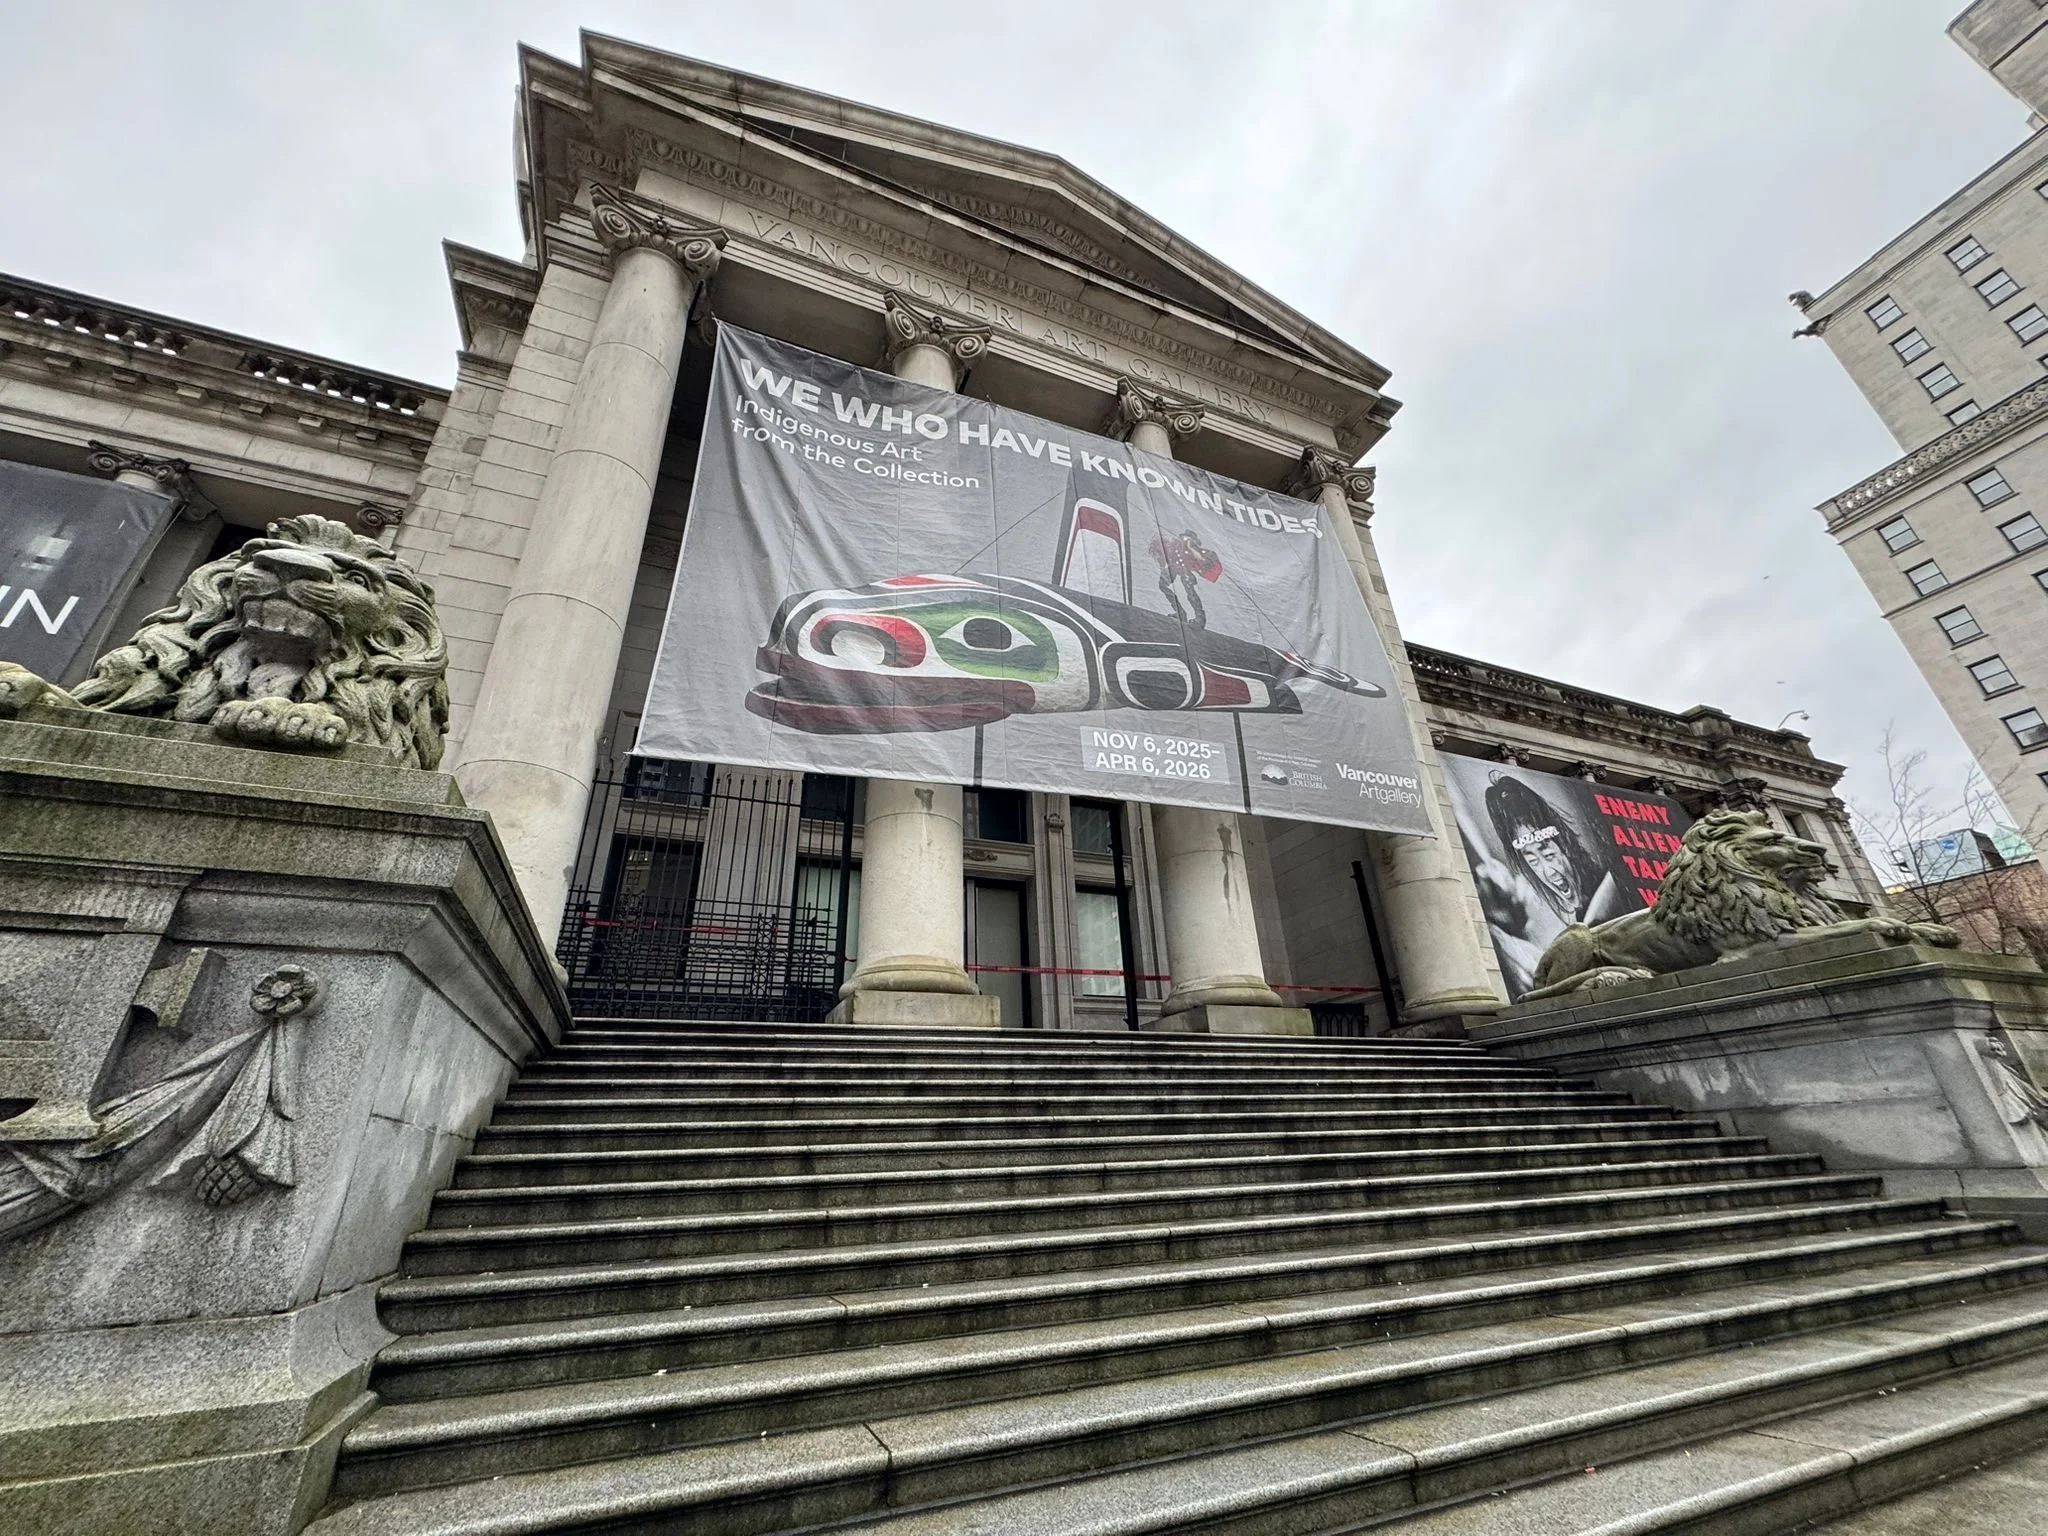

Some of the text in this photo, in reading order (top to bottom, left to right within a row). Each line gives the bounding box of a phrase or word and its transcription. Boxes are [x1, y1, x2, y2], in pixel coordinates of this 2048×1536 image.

[747, 211, 1273, 425] VANCOUVER ART GALLERY
[735, 394, 923, 463] Indigenous Art
[731, 418, 980, 489] from the Collection
[739, 358, 1323, 539] WE WHO HAVE KNOWN TIDES
[1093, 731, 1138, 751] NOV
[1143, 736, 1161, 755] 6,
[1095, 752, 1211, 779] APR 6, 2026
[1335, 763, 1418, 790] Vancouver
[1359, 783, 1422, 809] Artgallery
[1594, 794, 1671, 825] ENEMY
[1613, 825, 1682, 853] ALIEN
